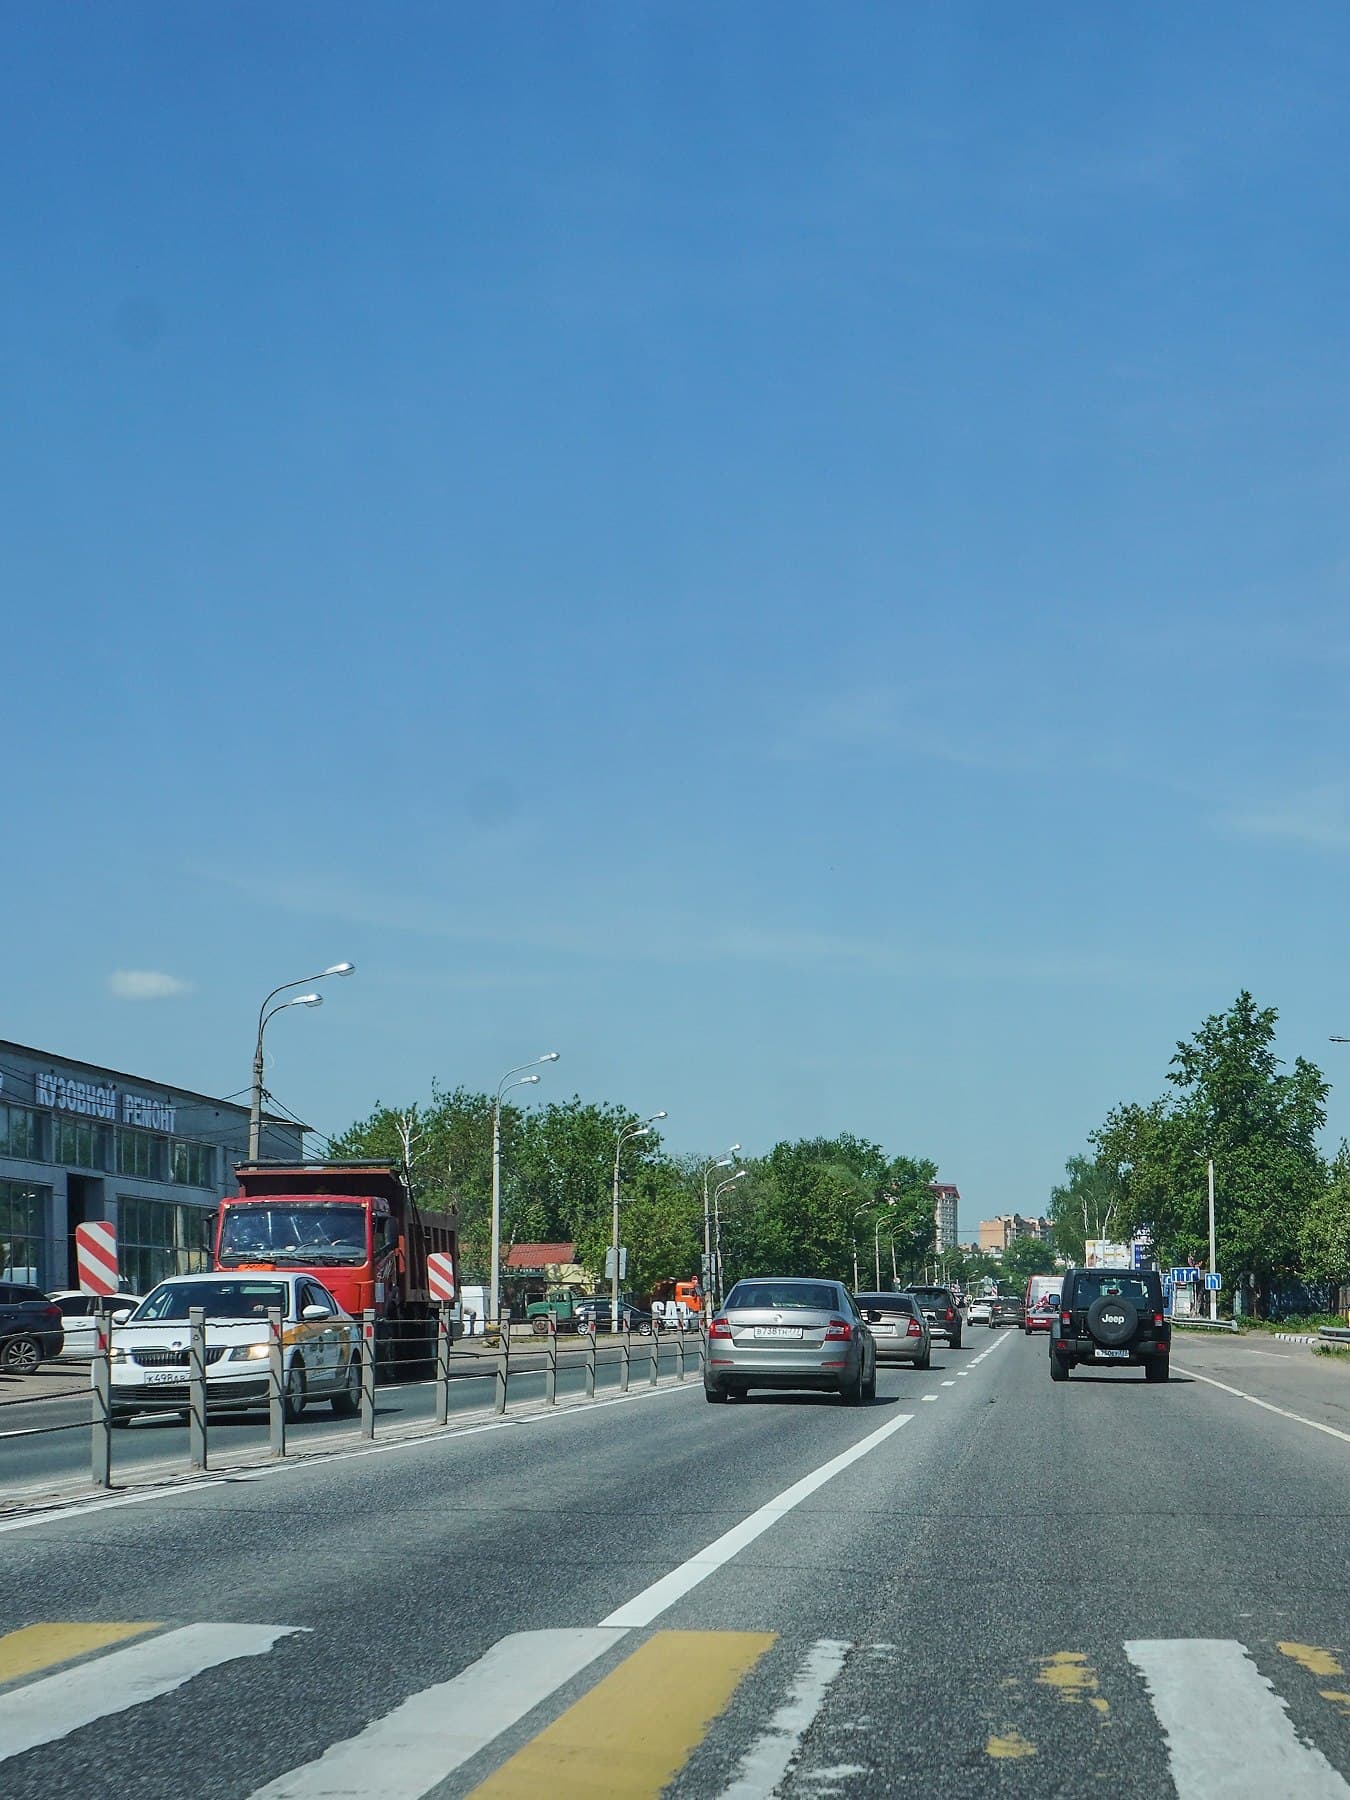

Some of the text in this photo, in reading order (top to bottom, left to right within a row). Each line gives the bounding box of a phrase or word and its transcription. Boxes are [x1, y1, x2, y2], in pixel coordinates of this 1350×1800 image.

[37, 1073, 117, 1120] КУЗОВНОЙ
[122, 1094, 177, 1133] РЕМОНТ
[1101, 1313, 1125, 1325] Jeep
